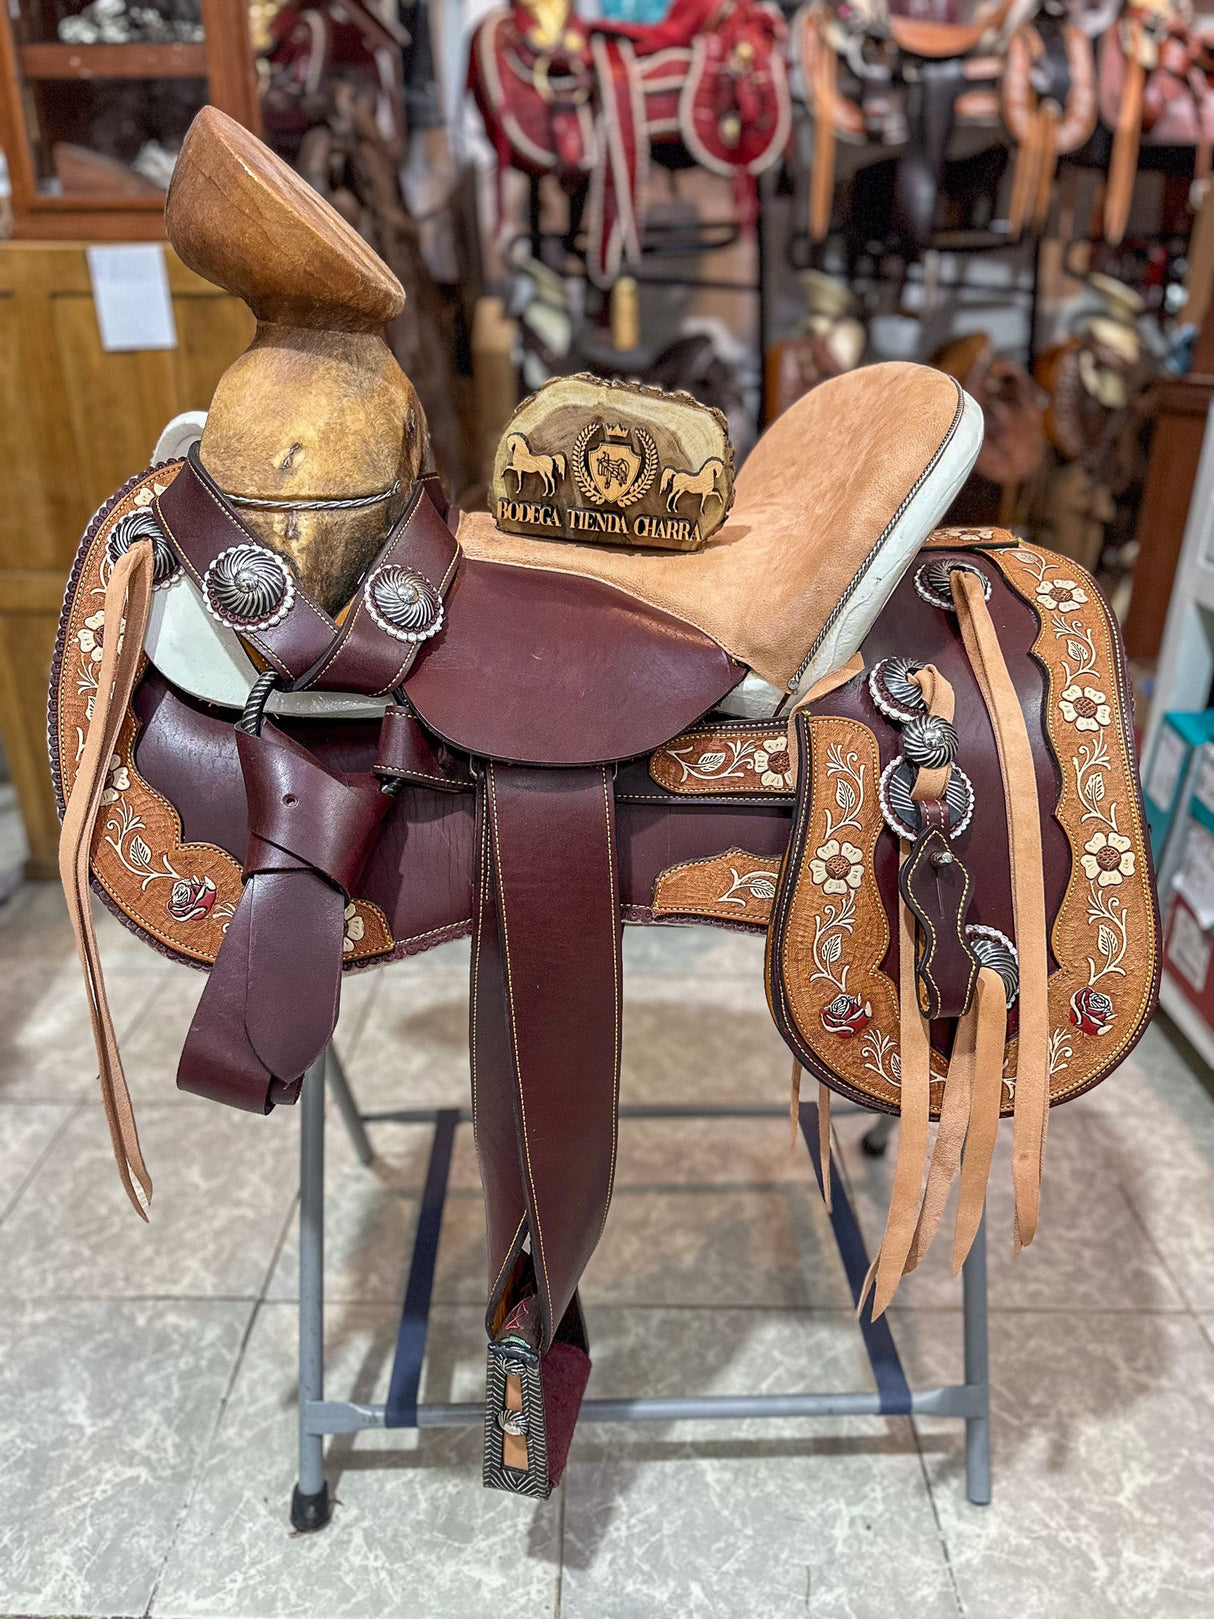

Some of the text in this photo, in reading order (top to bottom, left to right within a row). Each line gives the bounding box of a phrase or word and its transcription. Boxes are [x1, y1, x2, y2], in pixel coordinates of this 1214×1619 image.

[497, 500, 701, 542] BODEGA TIENDA CHARRA
